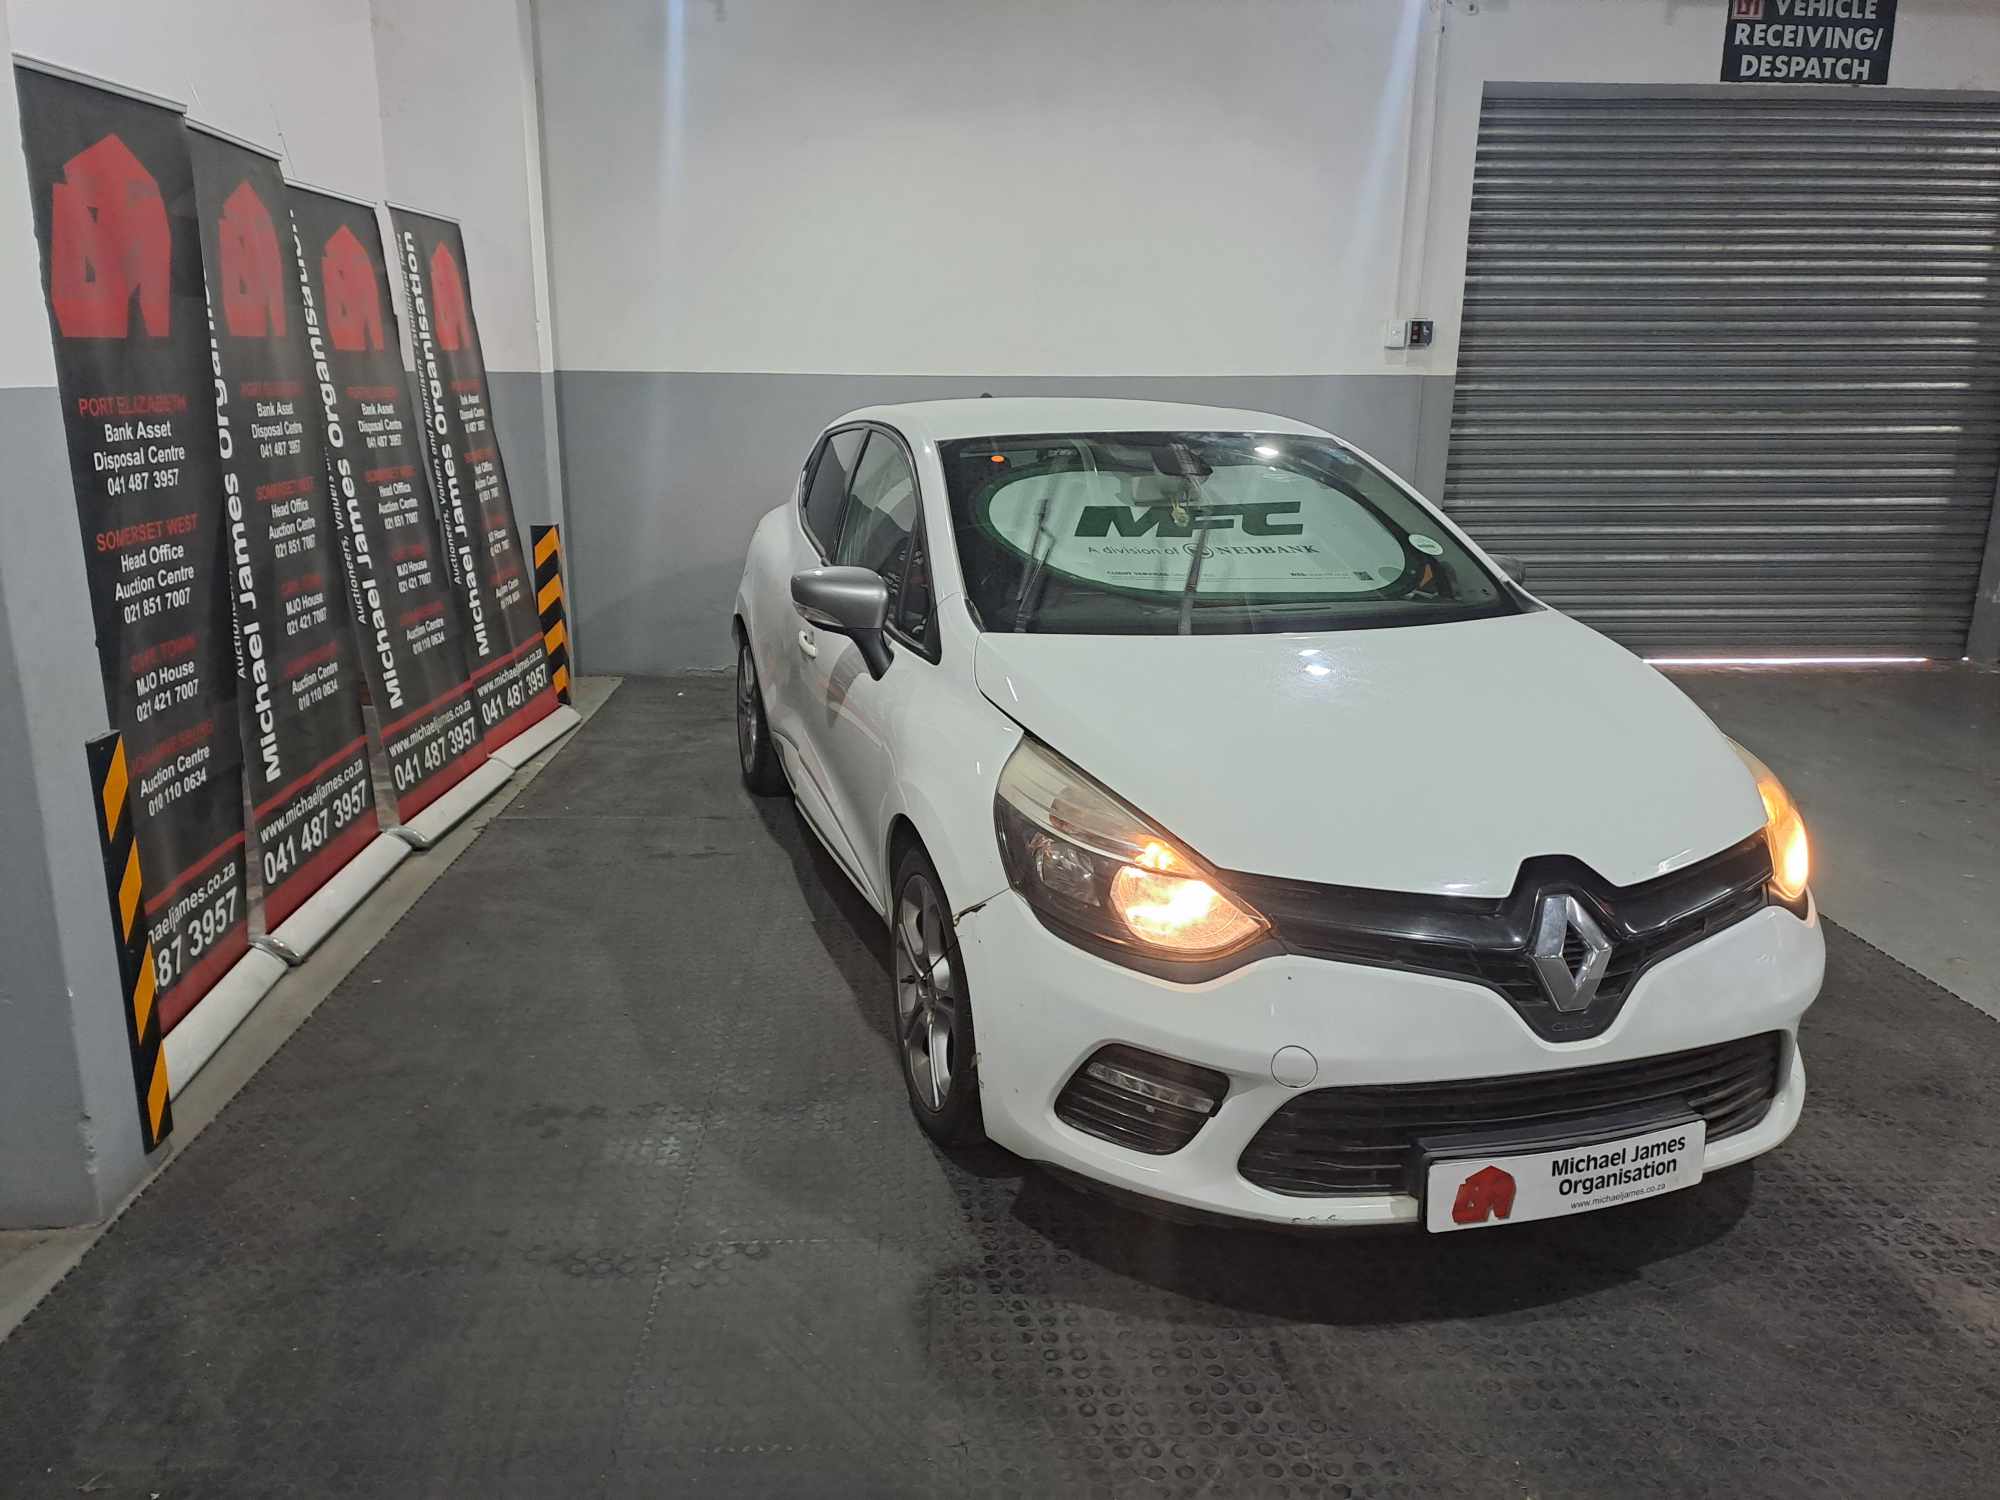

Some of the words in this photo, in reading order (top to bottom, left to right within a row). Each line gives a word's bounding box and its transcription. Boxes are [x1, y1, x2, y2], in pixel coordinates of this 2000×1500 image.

[1776, 0, 1878, 19] VEHICLE
[1734, 23, 1884, 51] RECEIVING/
[1740, 54, 1871, 81] DESPATCH
[290, 209, 344, 449] Organisa
[403, 231, 448, 436] Organisation
[79, 397, 115, 417] PORT
[256, 402, 276, 417] Bank
[104, 421, 134, 442] Bank
[136, 420, 172, 440] Asset
[251, 421, 284, 440] Disposal
[93, 447, 145, 472] Disposal
[148, 445, 186, 464] Centre
[260, 442, 273, 458] 041
[107, 476, 126, 497] 041
[128, 472, 149, 492] 487
[152, 468, 179, 489] 3957
[441, 443, 468, 538] James
[270, 501, 289, 519] Head
[337, 458, 374, 570] James
[1074, 501, 1304, 538] MFC
[95, 520, 164, 552] SOMERSET
[165, 511, 198, 538] WEST
[224, 472, 258, 610] James
[268, 522, 296, 540] Auction
[274, 542, 288, 559] 021
[288, 538, 301, 554] 851
[1102, 543, 1163, 555] division
[1214, 544, 1320, 555] NEDBANK
[120, 549, 147, 573] Head
[149, 543, 185, 564] Office
[115, 575, 155, 601] Auction
[157, 565, 195, 587] Centre
[458, 545, 490, 657] Michael
[124, 605, 141, 624] 021
[142, 595, 162, 617] 851
[165, 586, 191, 610] 7007
[286, 620, 299, 636] 021
[299, 612, 312, 629] 421
[362, 578, 404, 710] Michael
[136, 670, 157, 697] MJO
[159, 660, 195, 686] House
[292, 671, 318, 696] Auction
[317, 662, 339, 680] Centre
[481, 693, 505, 726] 041
[525, 663, 548, 696] 3957
[136, 700, 152, 723] 021
[153, 689, 172, 712] 421
[174, 678, 199, 703] 7007
[243, 621, 282, 784] Michael
[140, 764, 175, 798] Auction
[176, 745, 210, 772] Centre
[394, 753, 422, 791] 041
[424, 737, 447, 771] 487
[447, 717, 477, 755] 3957
[148, 796, 164, 817] 010
[164, 780, 182, 804] 110
[183, 767, 207, 793] 0634
[259, 758, 364, 844] www.michaeljames.co.za
[264, 835, 297, 885] 041
[301, 808, 329, 853] 487
[332, 778, 367, 829] 3957
[155, 934, 183, 994] 87
[187, 886, 239, 958] 3957
[1551, 1147, 1626, 1177] Michael
[1631, 1136, 1686, 1163] James
[1558, 1158, 1677, 1196] Organisation
[1570, 1182, 1666, 1209] www.michaeljames.co.za
